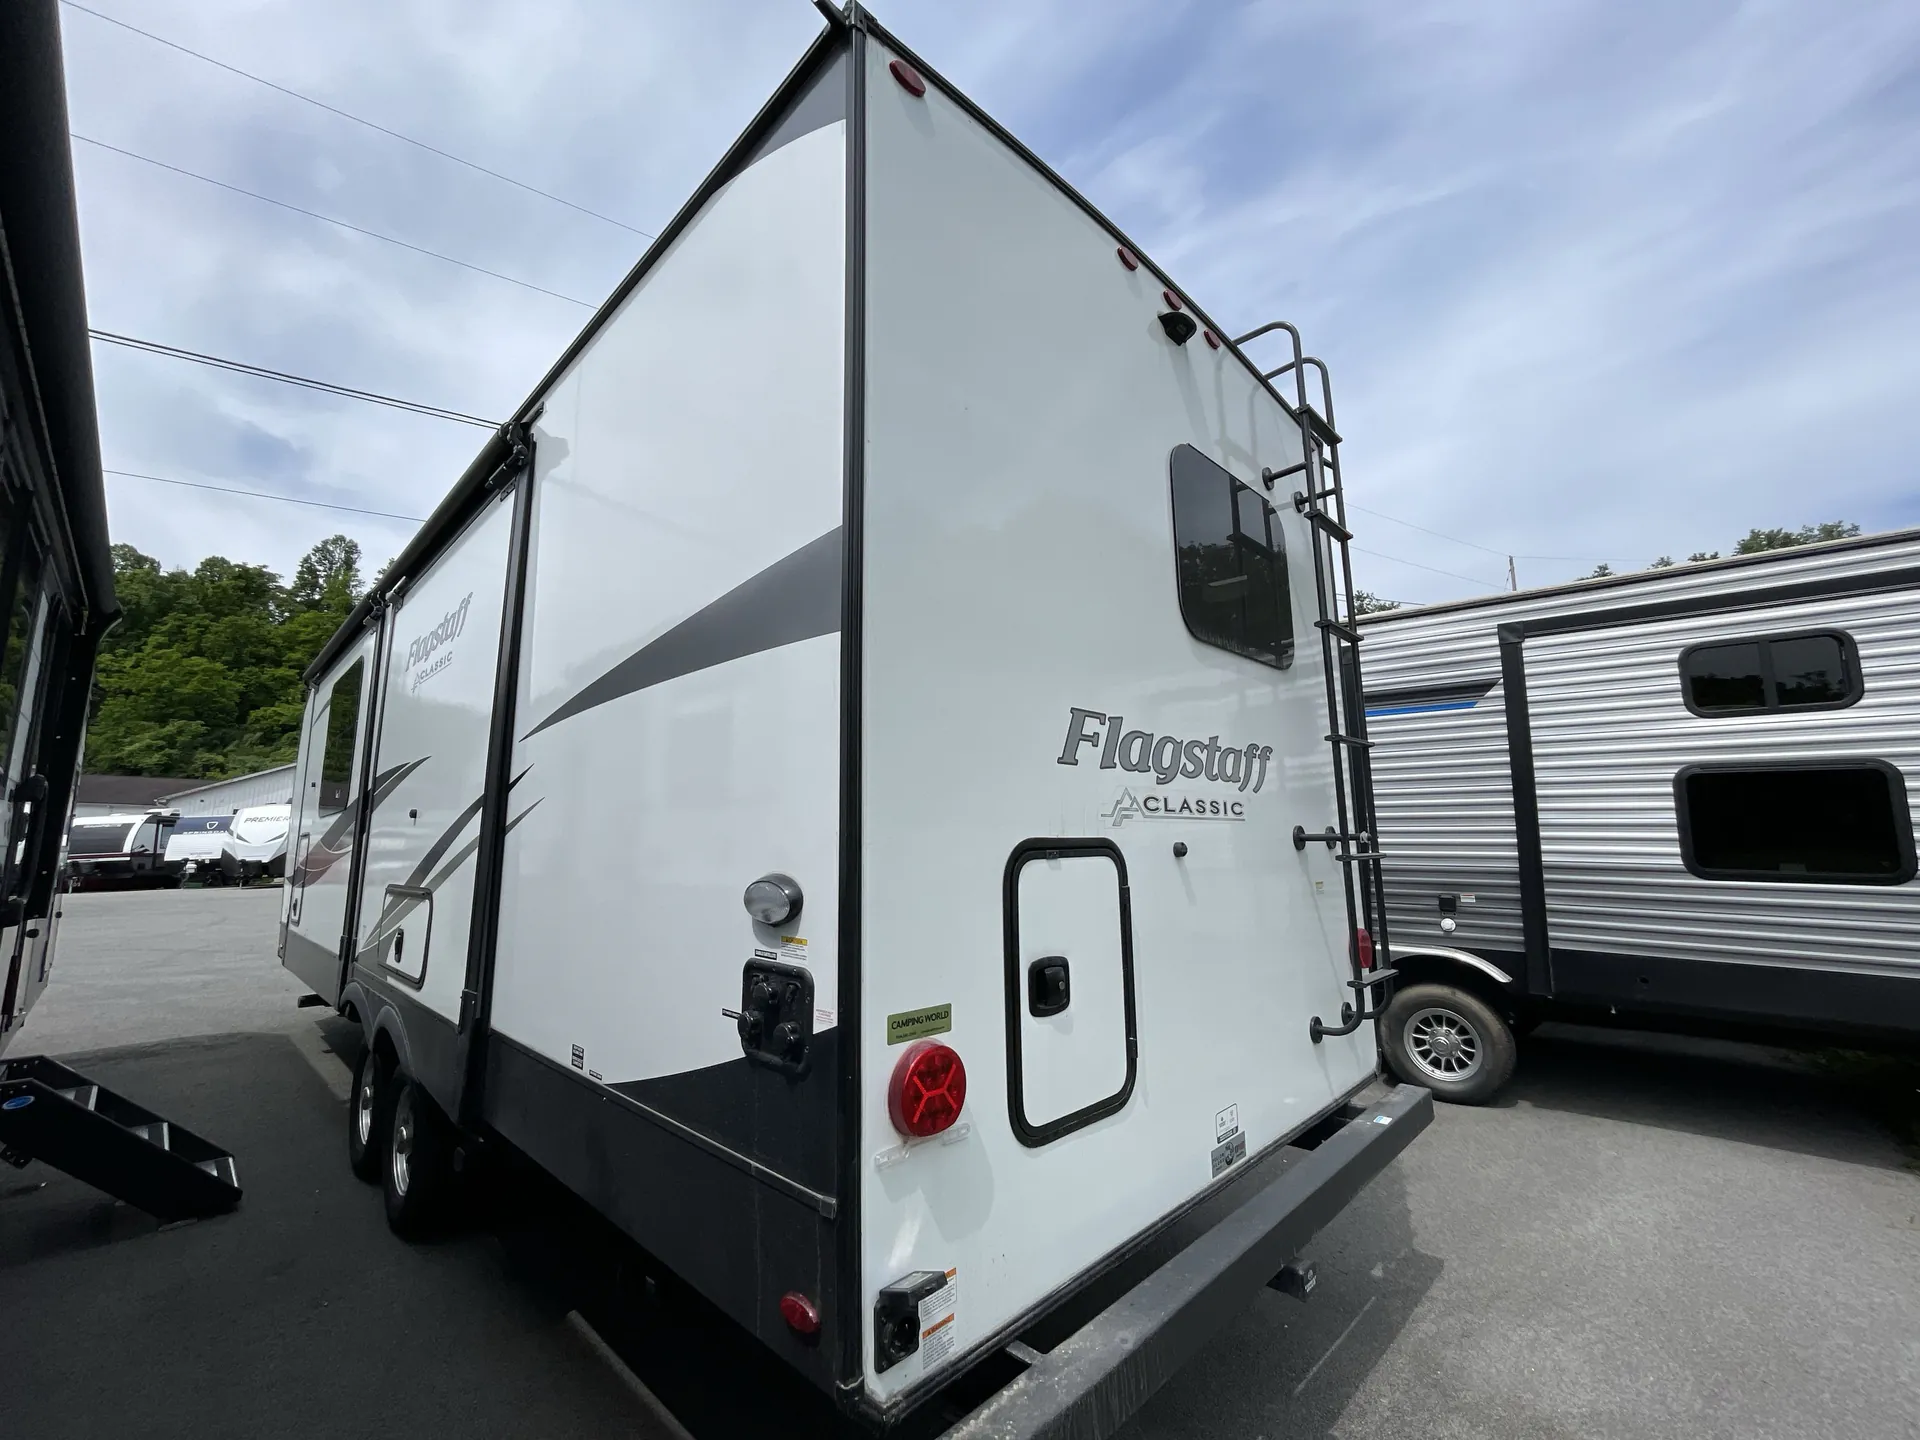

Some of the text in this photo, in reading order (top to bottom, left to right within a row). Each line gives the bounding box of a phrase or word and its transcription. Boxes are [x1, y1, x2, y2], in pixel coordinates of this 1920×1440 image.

[405, 591, 473, 672] Flagstaff
[420, 651, 453, 680] CLASSIC
[1057, 707, 1273, 793] Flagstaff
[1143, 796, 1244, 816] CLASSIC
[244, 816, 291, 824] PREMIER
[891, 1015, 924, 1030] CAMPING
[924, 1010, 949, 1023] WORLD
